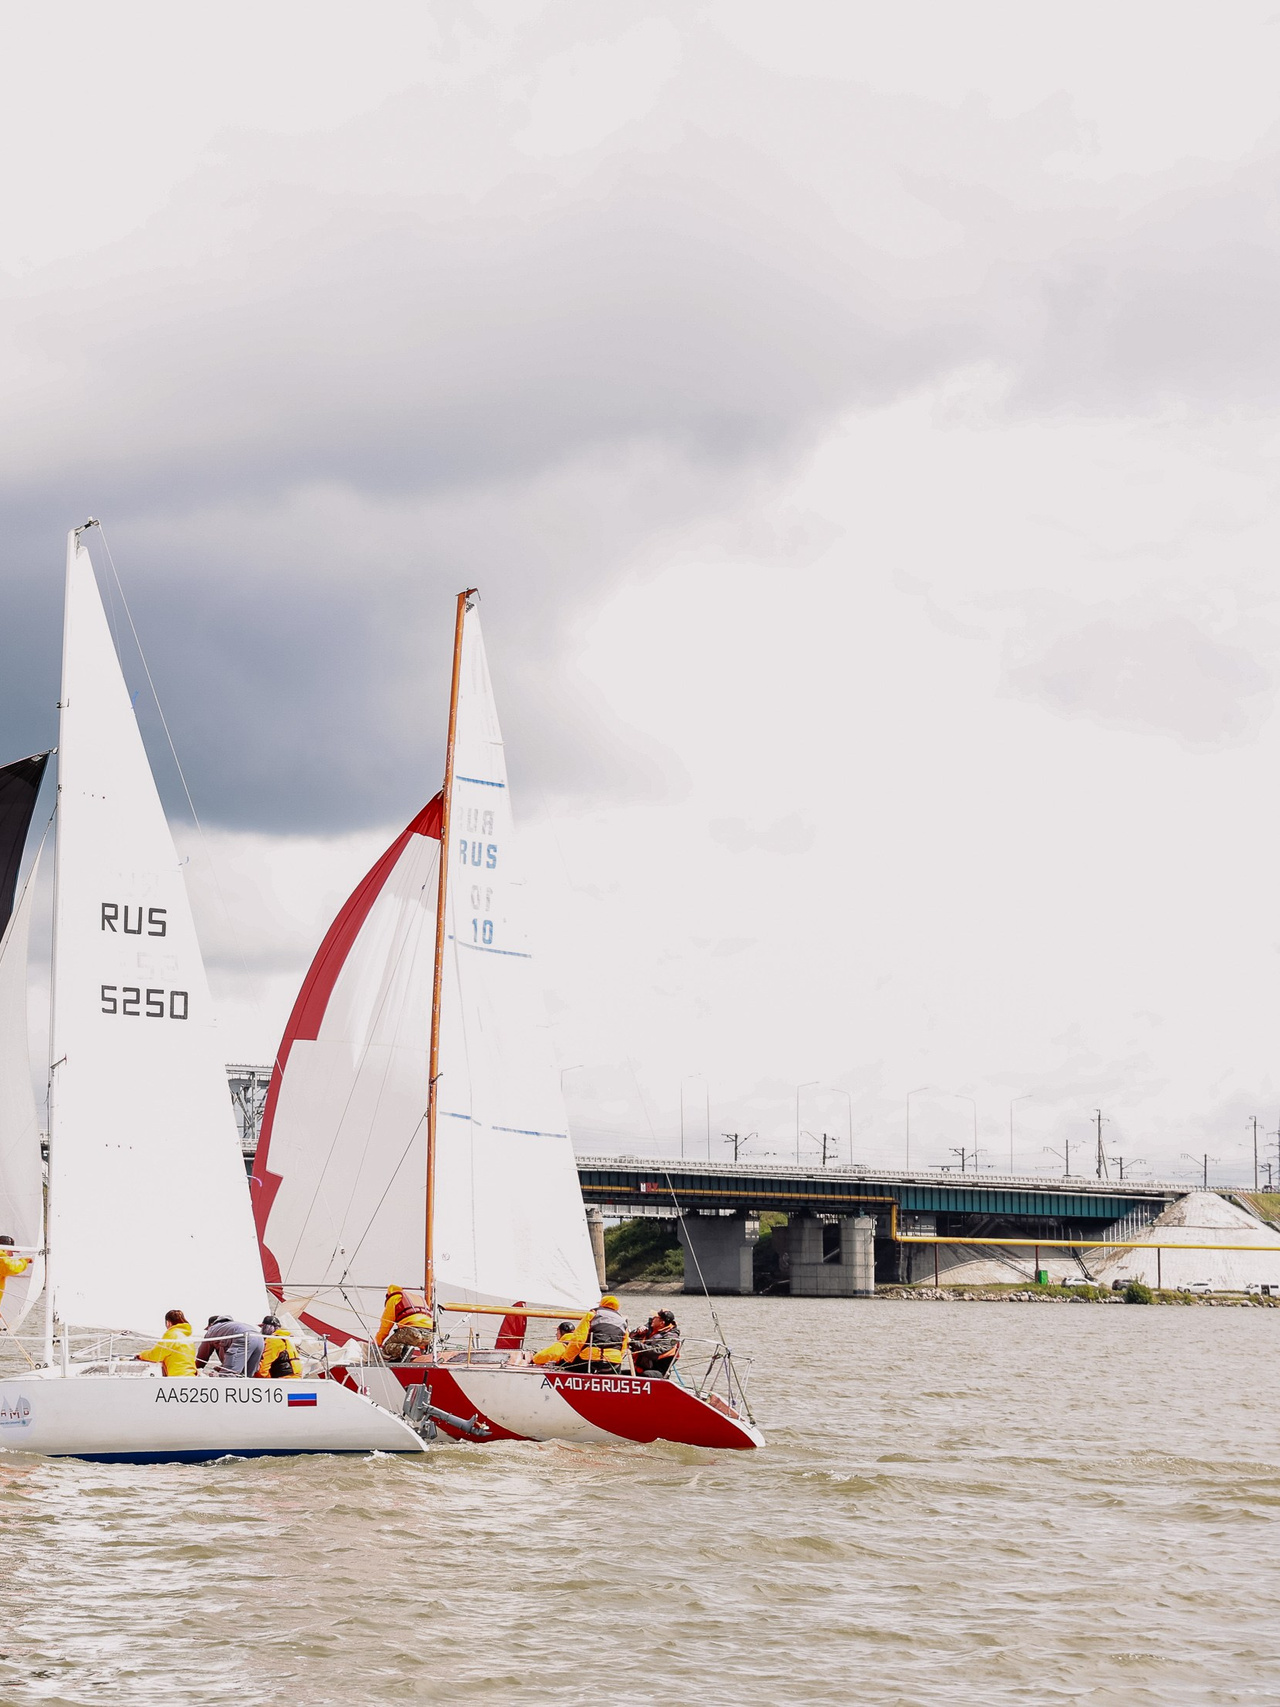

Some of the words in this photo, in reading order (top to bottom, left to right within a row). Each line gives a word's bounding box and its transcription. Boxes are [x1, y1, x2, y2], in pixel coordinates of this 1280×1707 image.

[459, 839, 498, 869] RUS
[101, 902, 167, 937] RUS
[472, 918, 494, 945] 10
[101, 984, 188, 1020] 5250
[155, 1387, 219, 1403] AA5250
[225, 1387, 283, 1403] RUS16
